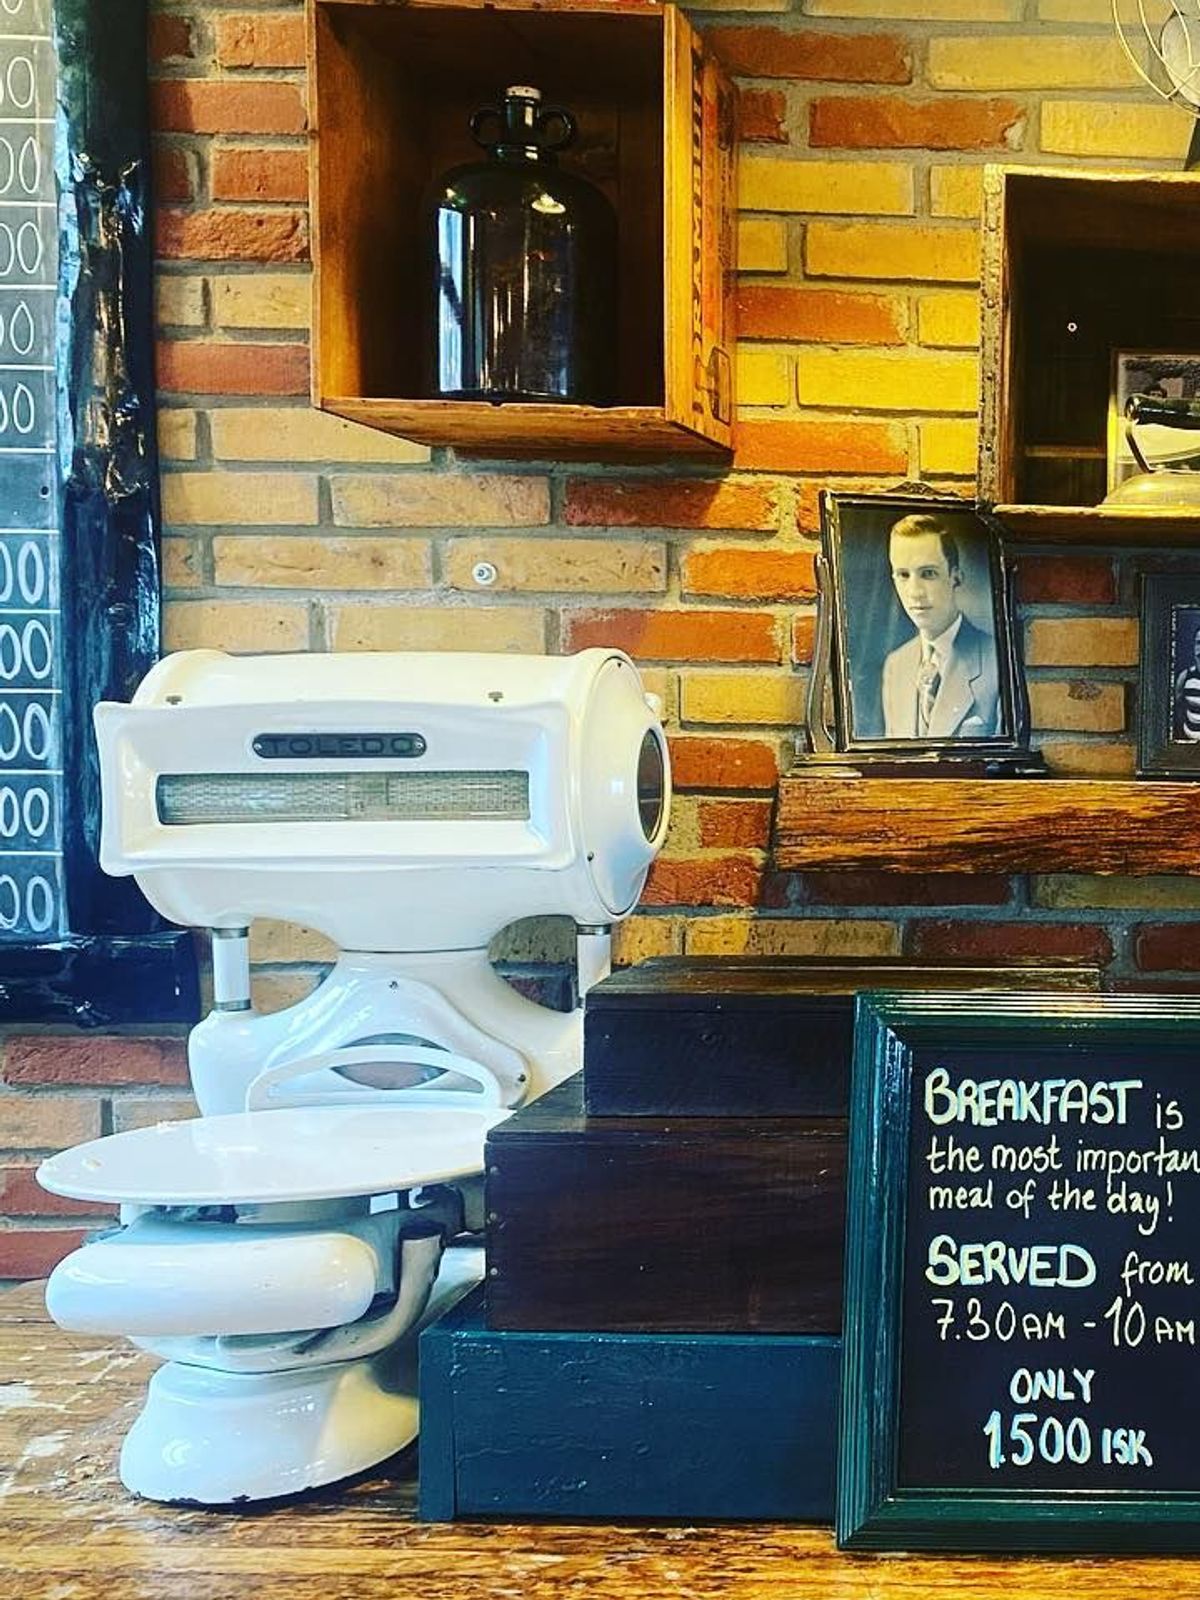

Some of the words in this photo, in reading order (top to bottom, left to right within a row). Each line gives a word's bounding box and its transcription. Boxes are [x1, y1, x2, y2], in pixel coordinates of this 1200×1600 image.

[0, 56, 35, 109] 0
[0, 300, 34, 355] 0
[266, 738, 414, 755] TOLEDO
[924, 1067, 1143, 1127] BREAKFAST
[1156, 1093, 1184, 1131] is
[926, 1134, 983, 1173] the
[992, 1134, 1063, 1171] most
[929, 1180, 993, 1210] meal
[1006, 1181, 1037, 1218] of
[1048, 1182, 1097, 1212] the
[1107, 1181, 1174, 1236] day!
[925, 1234, 1097, 1288] SERVED
[1120, 1251, 1195, 1297] from
[1009, 1367, 1096, 1404] ONLY
[1101, 1428, 1154, 1467] ISK
